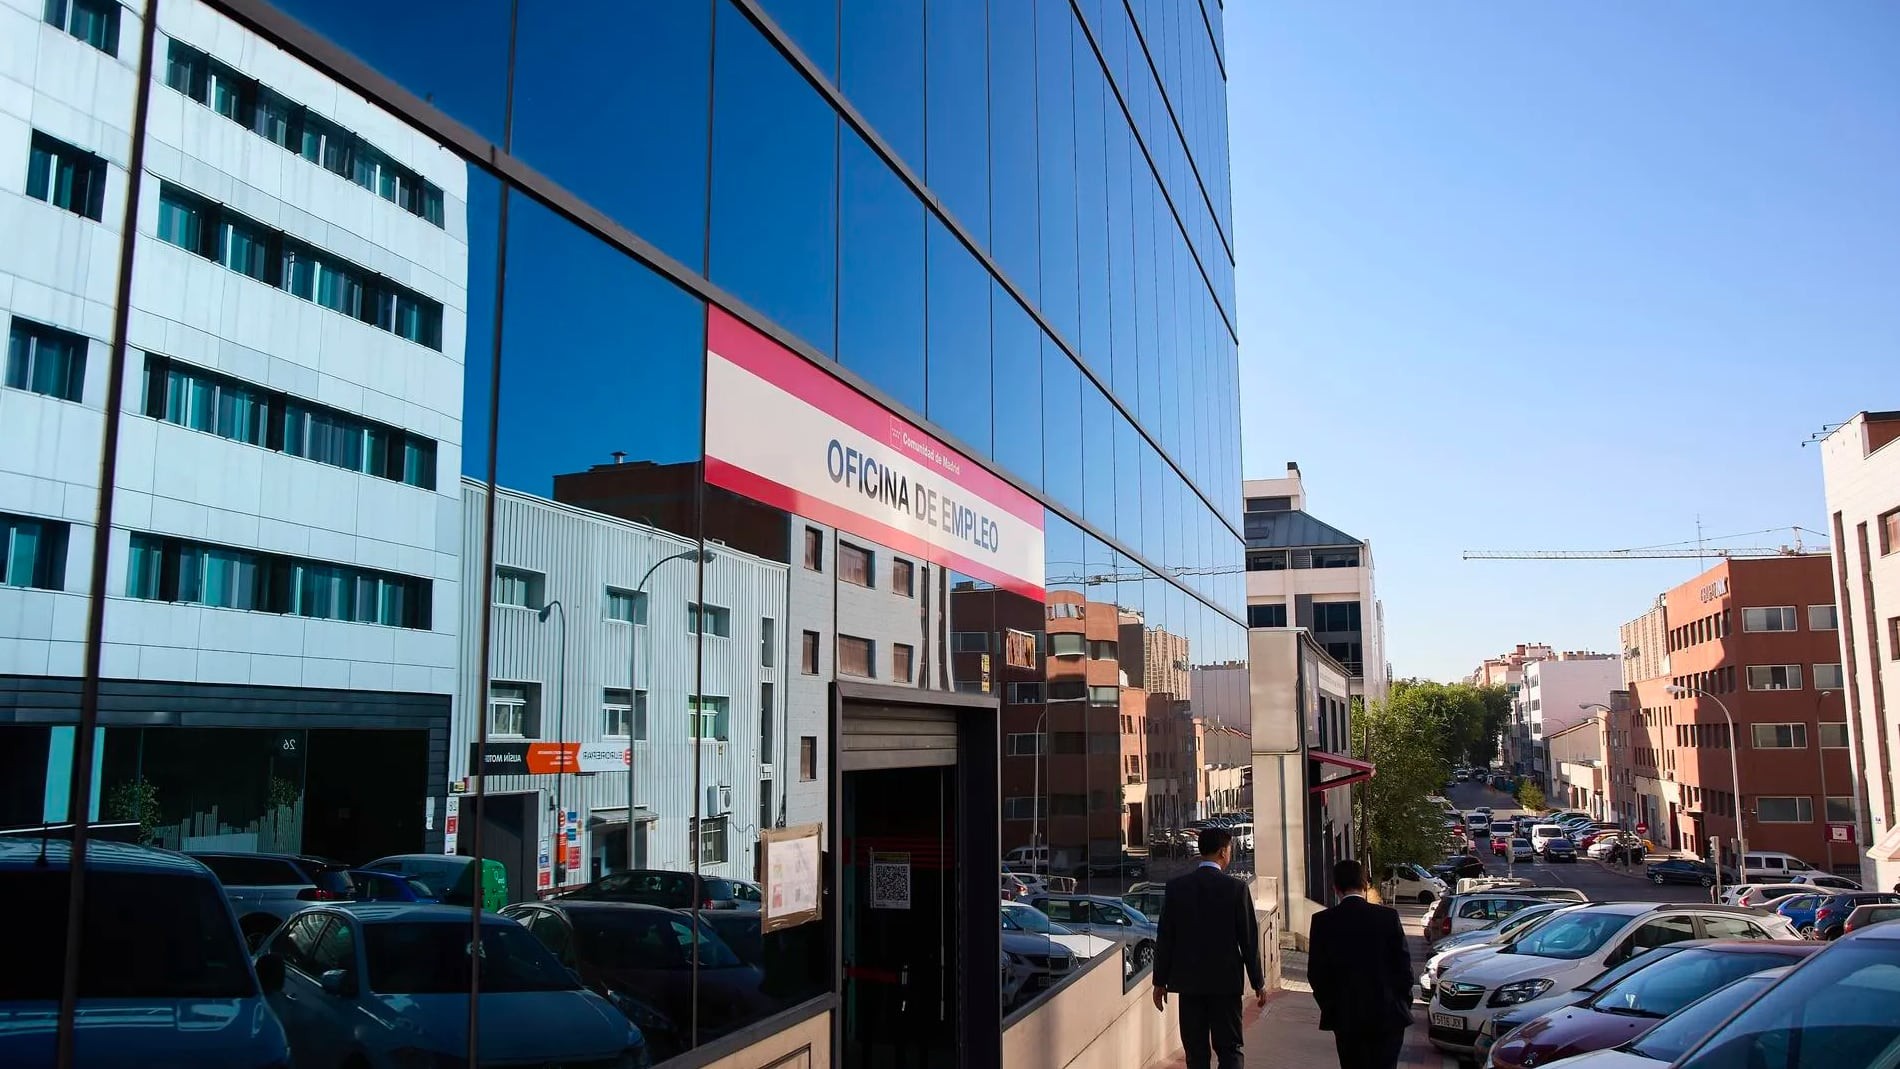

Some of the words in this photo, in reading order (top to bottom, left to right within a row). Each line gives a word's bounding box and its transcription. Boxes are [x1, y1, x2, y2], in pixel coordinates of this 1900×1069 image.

[903, 432, 935, 461] Comunidad
[935, 451, 942, 465] de
[943, 456, 960, 475] Madrid
[827, 439, 911, 515] OFICINA
[915, 482, 937, 527] DE
[942, 496, 999, 553] EMPLEO
